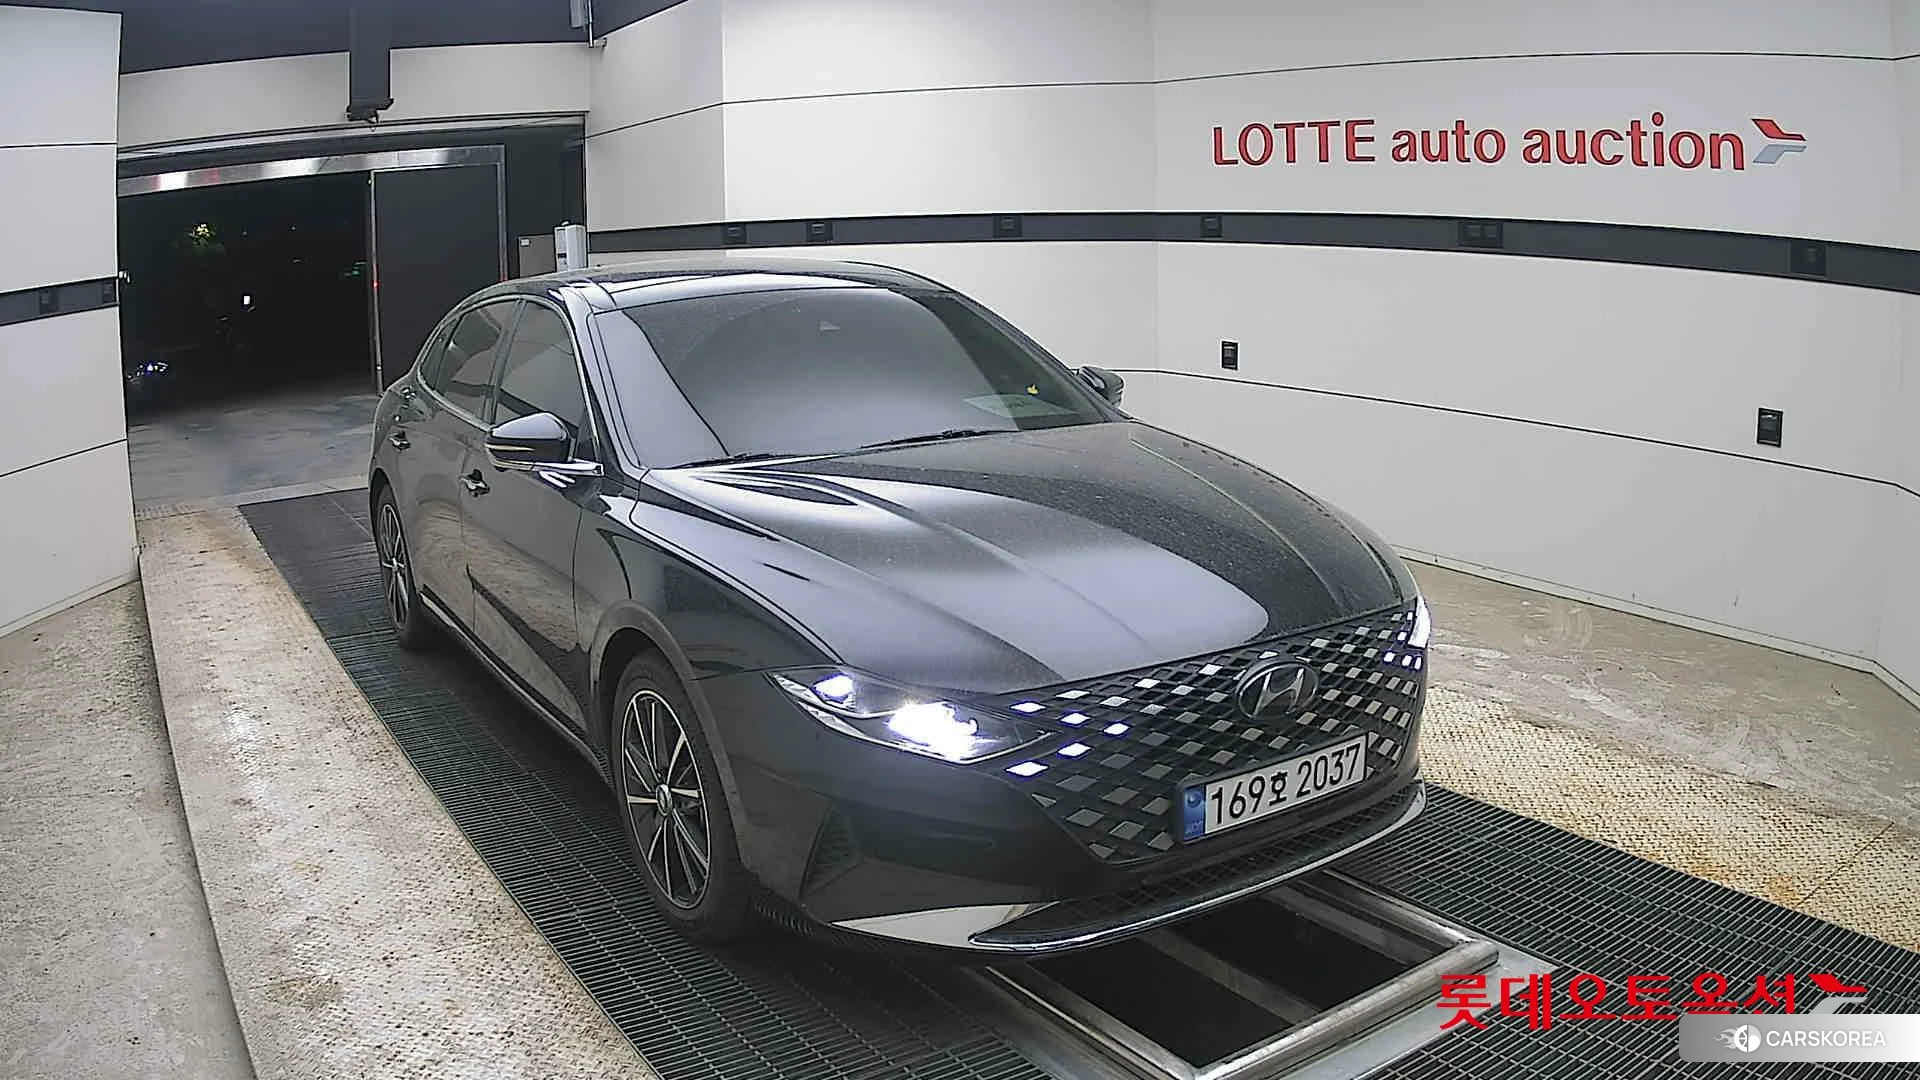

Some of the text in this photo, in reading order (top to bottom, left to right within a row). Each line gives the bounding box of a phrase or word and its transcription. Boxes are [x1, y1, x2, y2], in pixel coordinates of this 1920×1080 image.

[1213, 112, 1745, 170] LOTTE auto auction
[1210, 742, 1361, 826] 169호 2037
